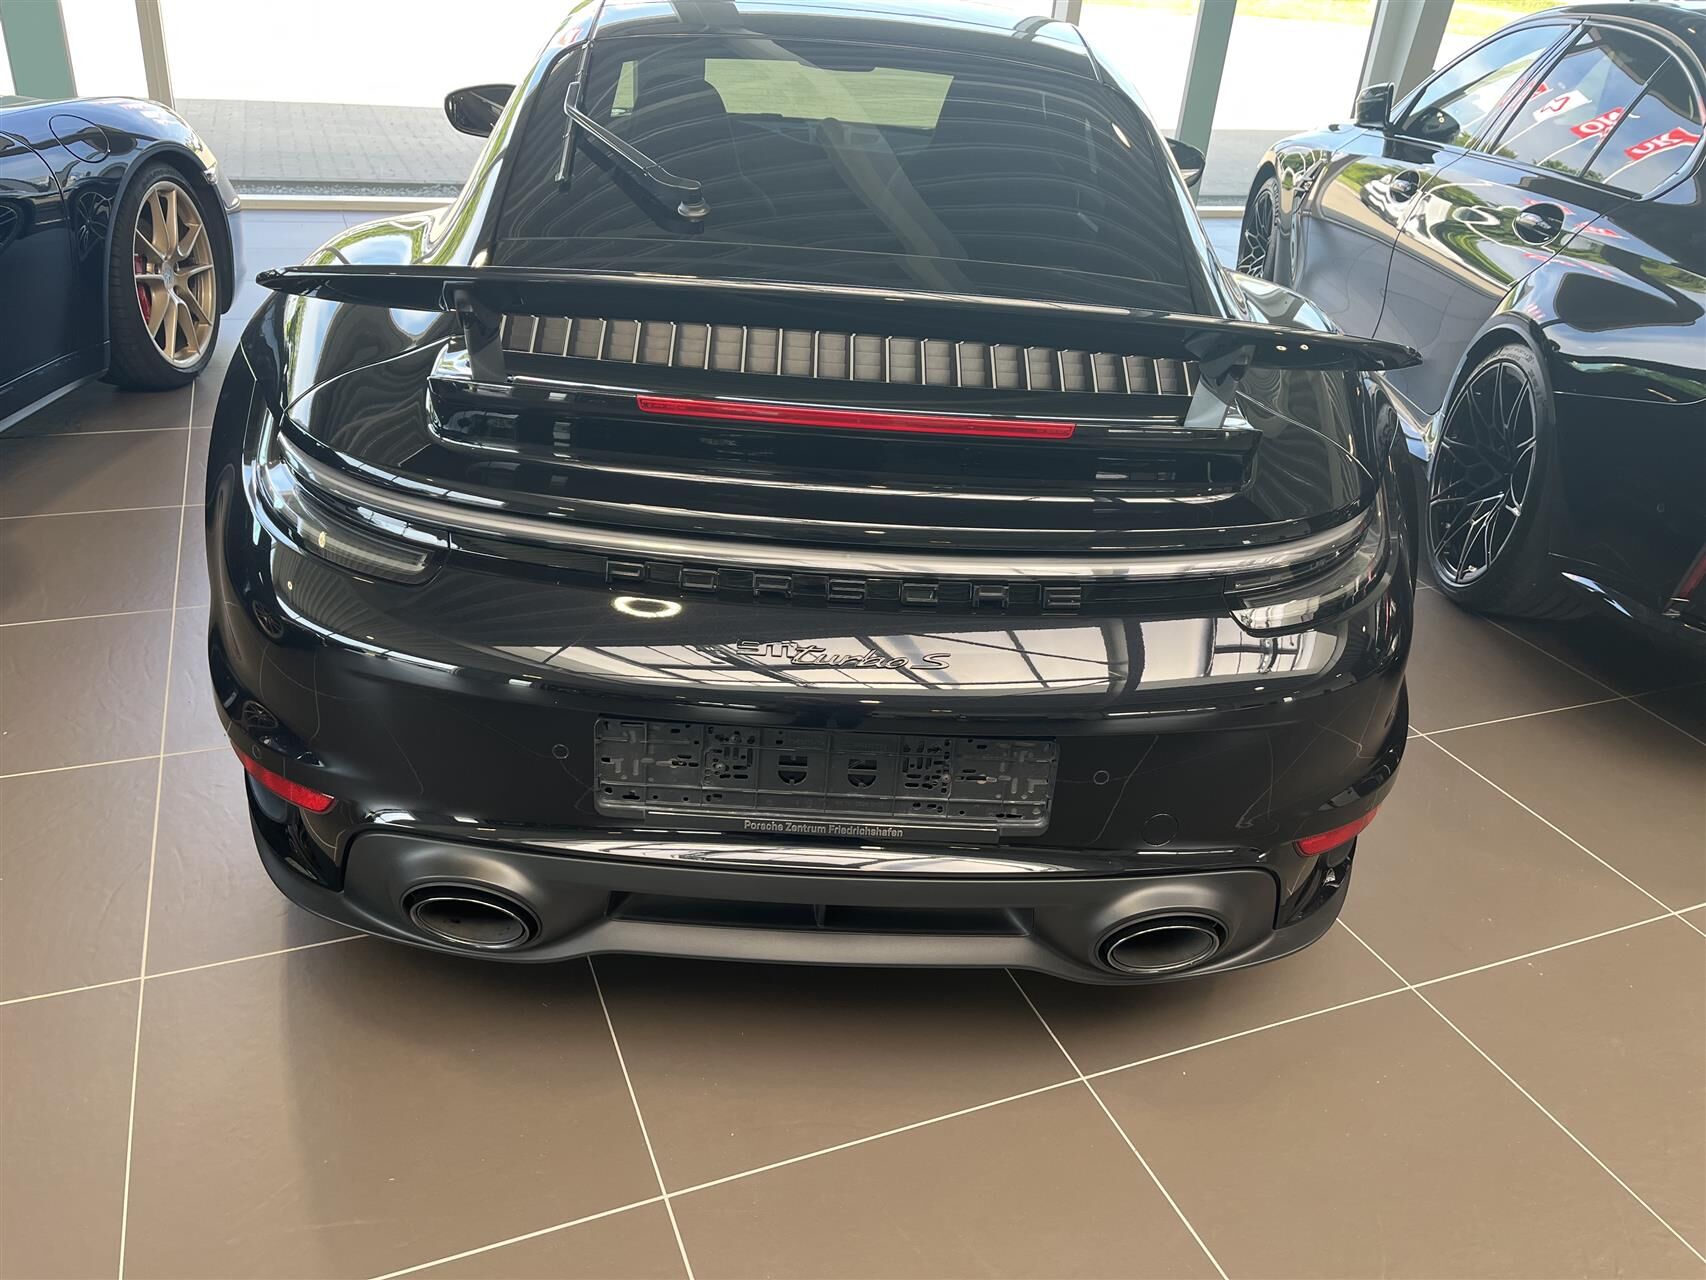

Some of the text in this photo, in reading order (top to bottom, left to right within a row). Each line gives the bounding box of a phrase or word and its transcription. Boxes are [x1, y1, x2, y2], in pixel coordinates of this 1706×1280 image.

[606, 560, 1081, 608] PORSCHE
[791, 646, 909, 669] turbo
[910, 653, 951, 670] S
[744, 820, 904, 837] Porsche Zentrum Friedrichshafen
